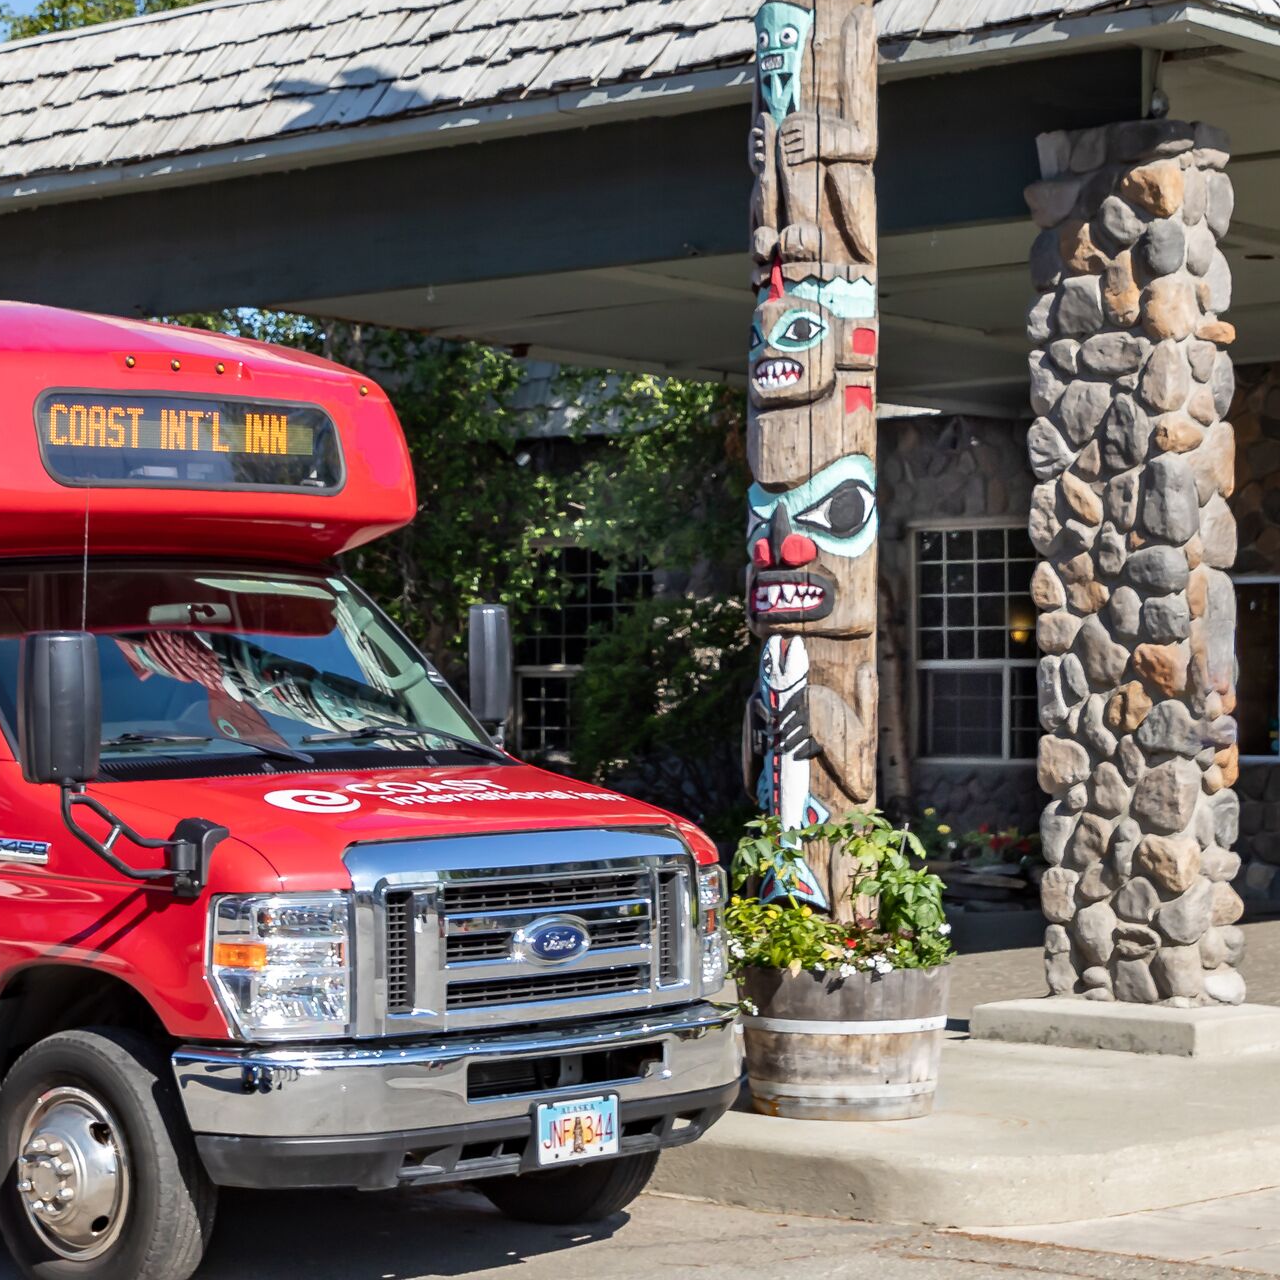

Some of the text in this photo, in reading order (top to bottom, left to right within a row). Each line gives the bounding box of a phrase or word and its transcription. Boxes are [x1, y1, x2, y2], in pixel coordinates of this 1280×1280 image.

[49, 403, 289, 455] COAST INT'L INN
[345, 779, 508, 796] COAST
[380, 790, 579, 806] international
[544, 931, 576, 951] Ford
[561, 1103, 595, 1114] ALASKA
[584, 1113, 614, 1144] 344
